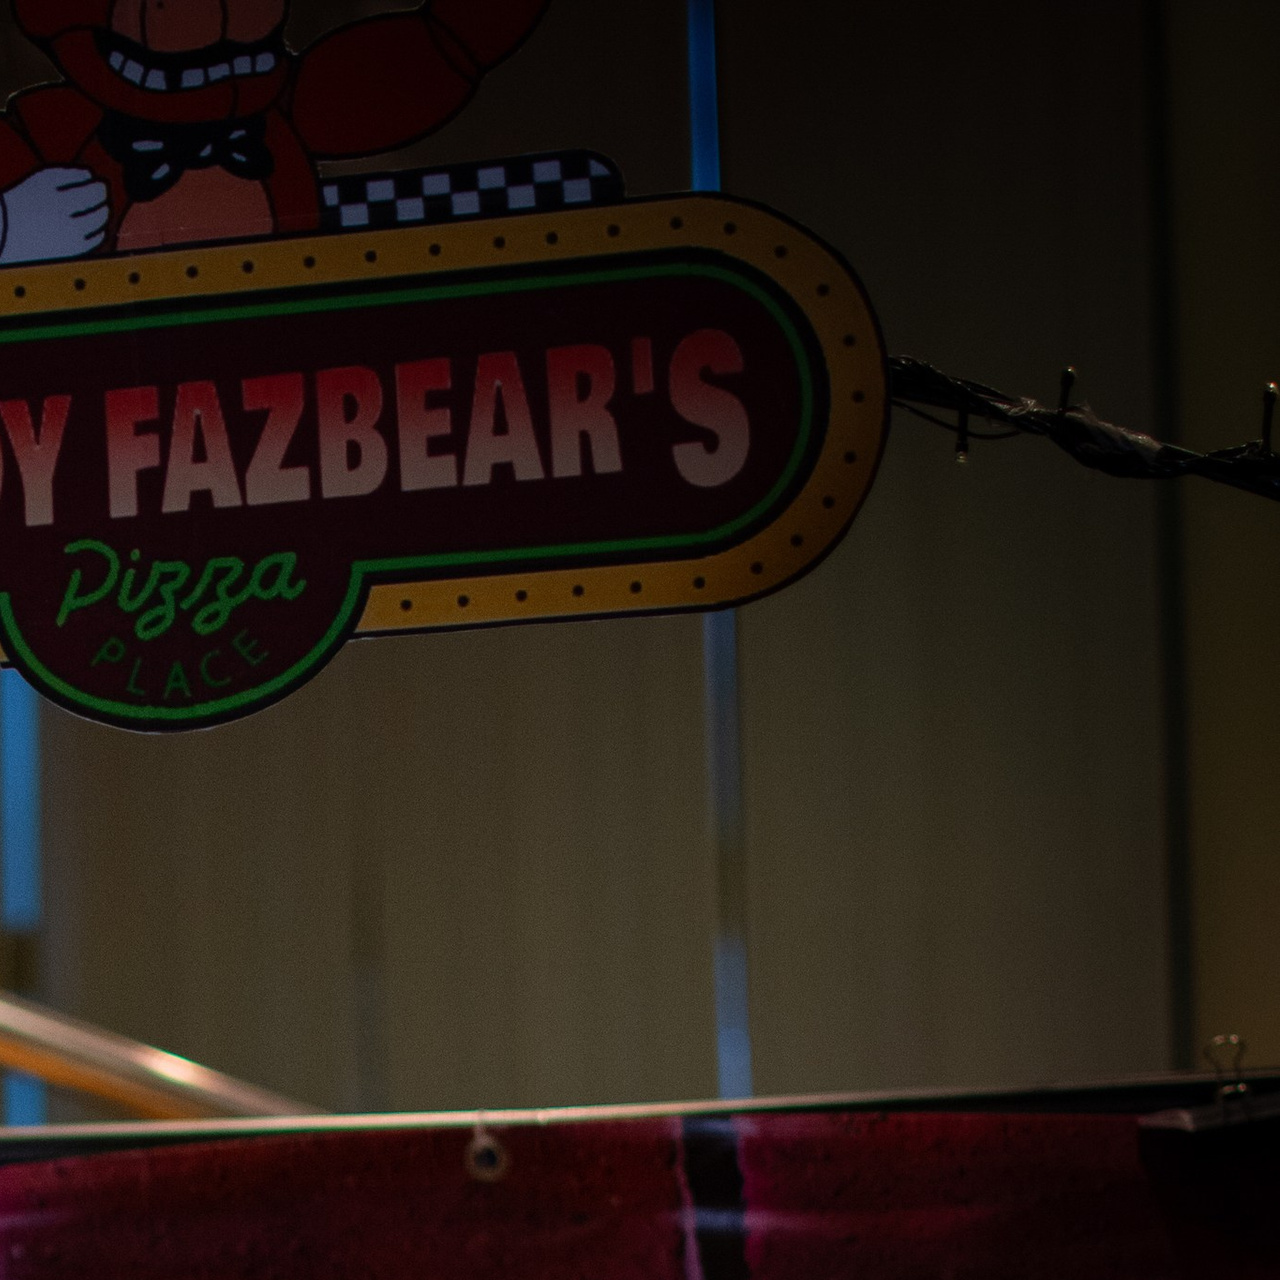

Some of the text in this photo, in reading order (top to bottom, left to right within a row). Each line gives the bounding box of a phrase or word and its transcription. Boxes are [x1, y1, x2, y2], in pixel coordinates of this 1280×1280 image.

[104, 328, 751, 520] FAZBEAR'S
[55, 538, 308, 642] Pizza
[89, 629, 269, 700] PLACE
